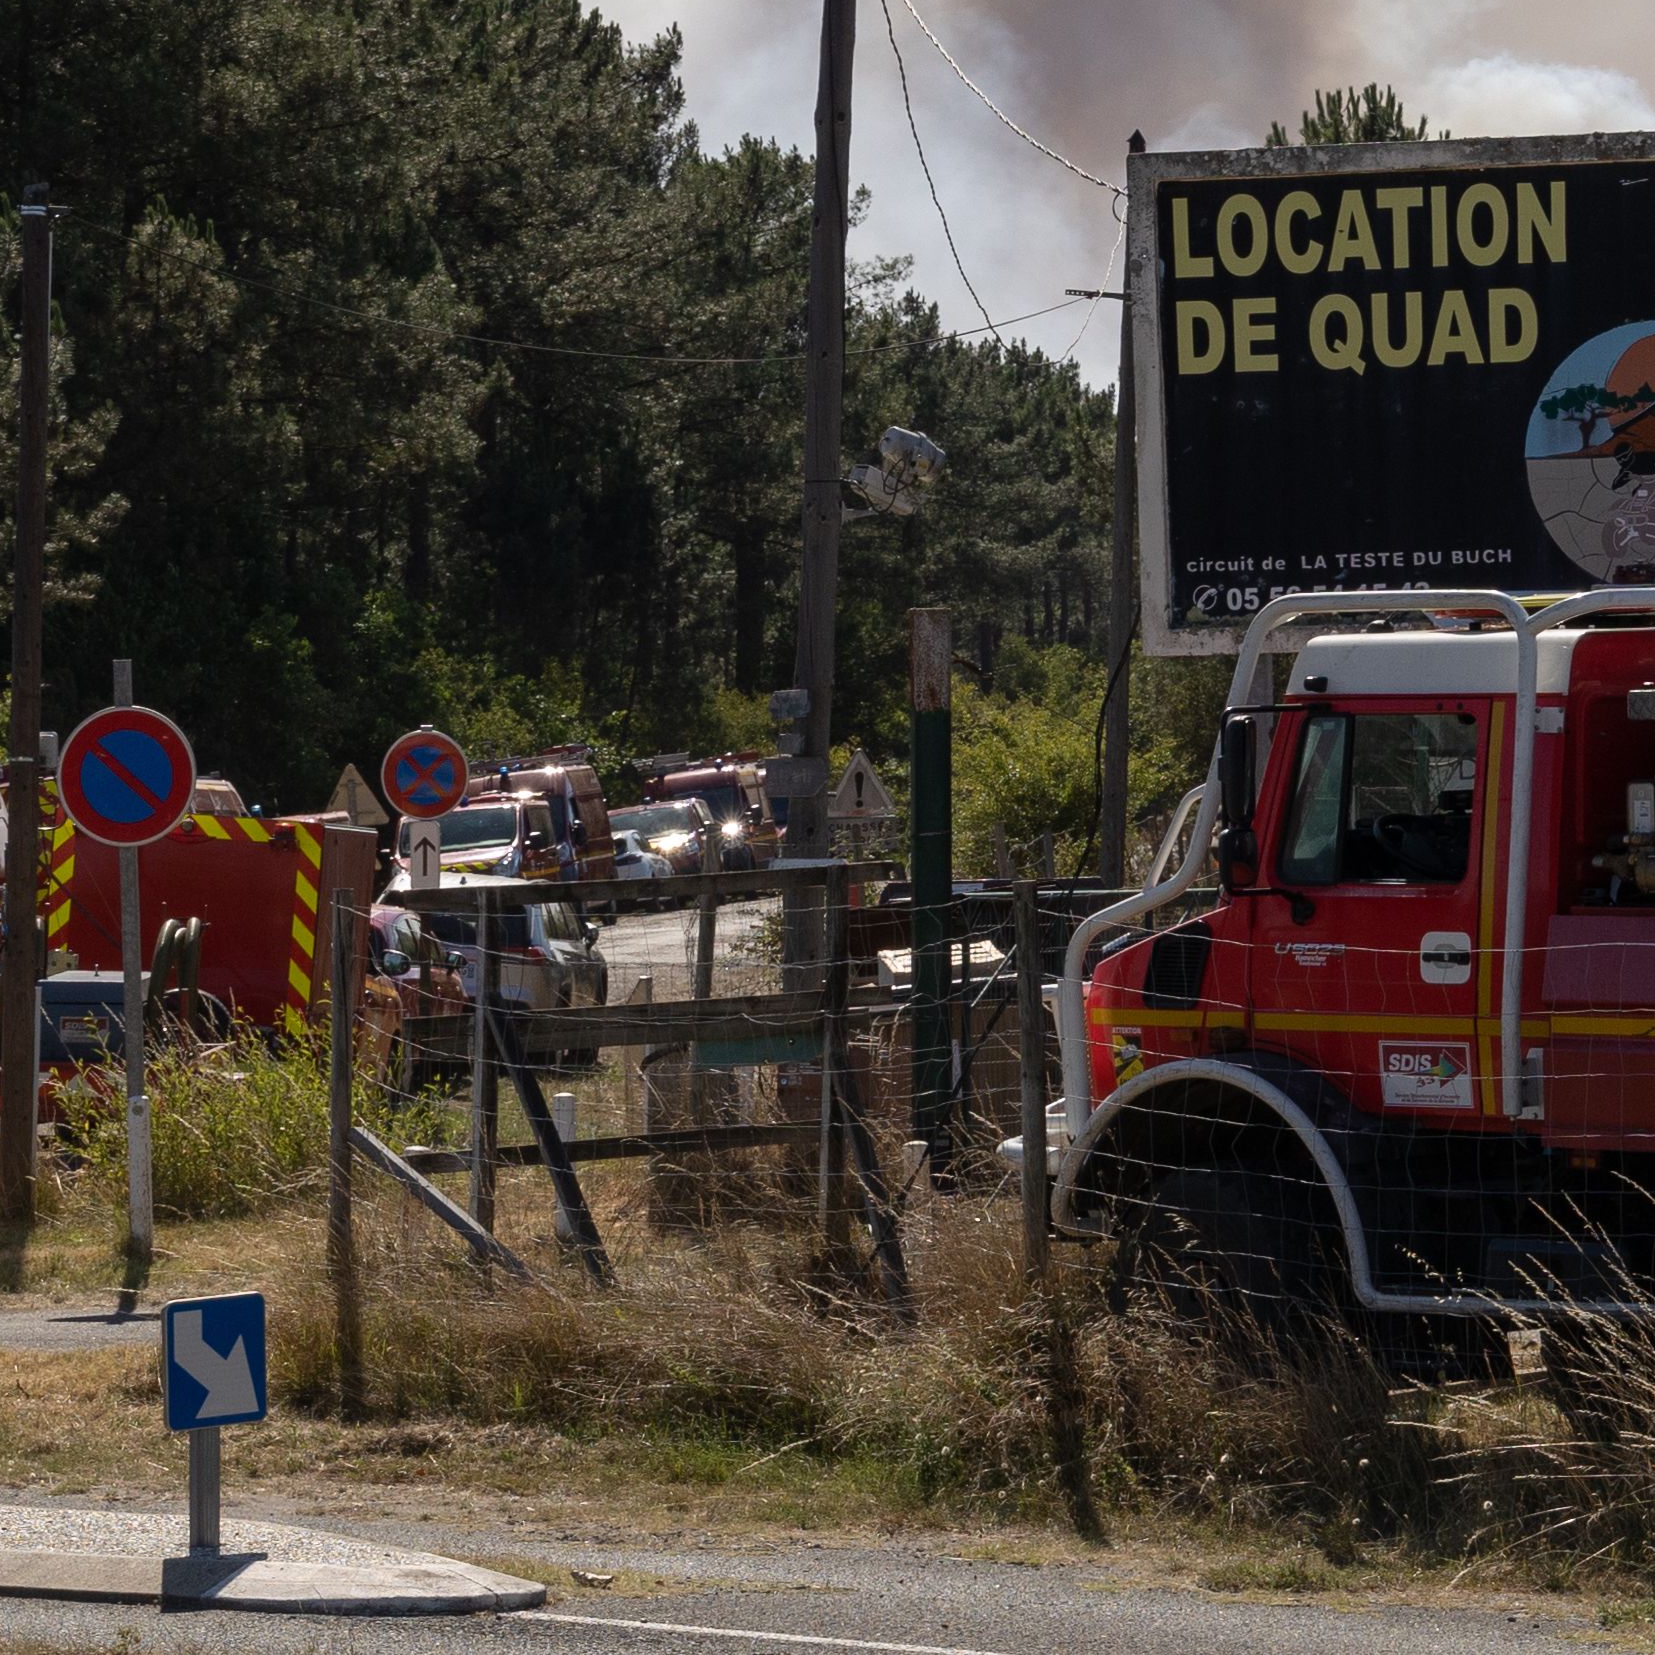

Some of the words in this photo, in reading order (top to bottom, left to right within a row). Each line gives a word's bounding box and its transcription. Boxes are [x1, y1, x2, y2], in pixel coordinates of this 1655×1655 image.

[1171, 181, 1567, 279] LOCATION
[1175, 297, 1280, 375] DE
[1308, 287, 1539, 376] QUAD
[1186, 556, 1254, 573] circuit
[1262, 555, 1286, 571] de
[1300, 554, 1328, 570] LA
[1336, 551, 1405, 569] TESTE
[1413, 550, 1443, 566] DU
[1451, 548, 1513, 565] BUCH
[1225, 586, 1260, 611] 05
[1388, 1053, 1433, 1072] SDIS
